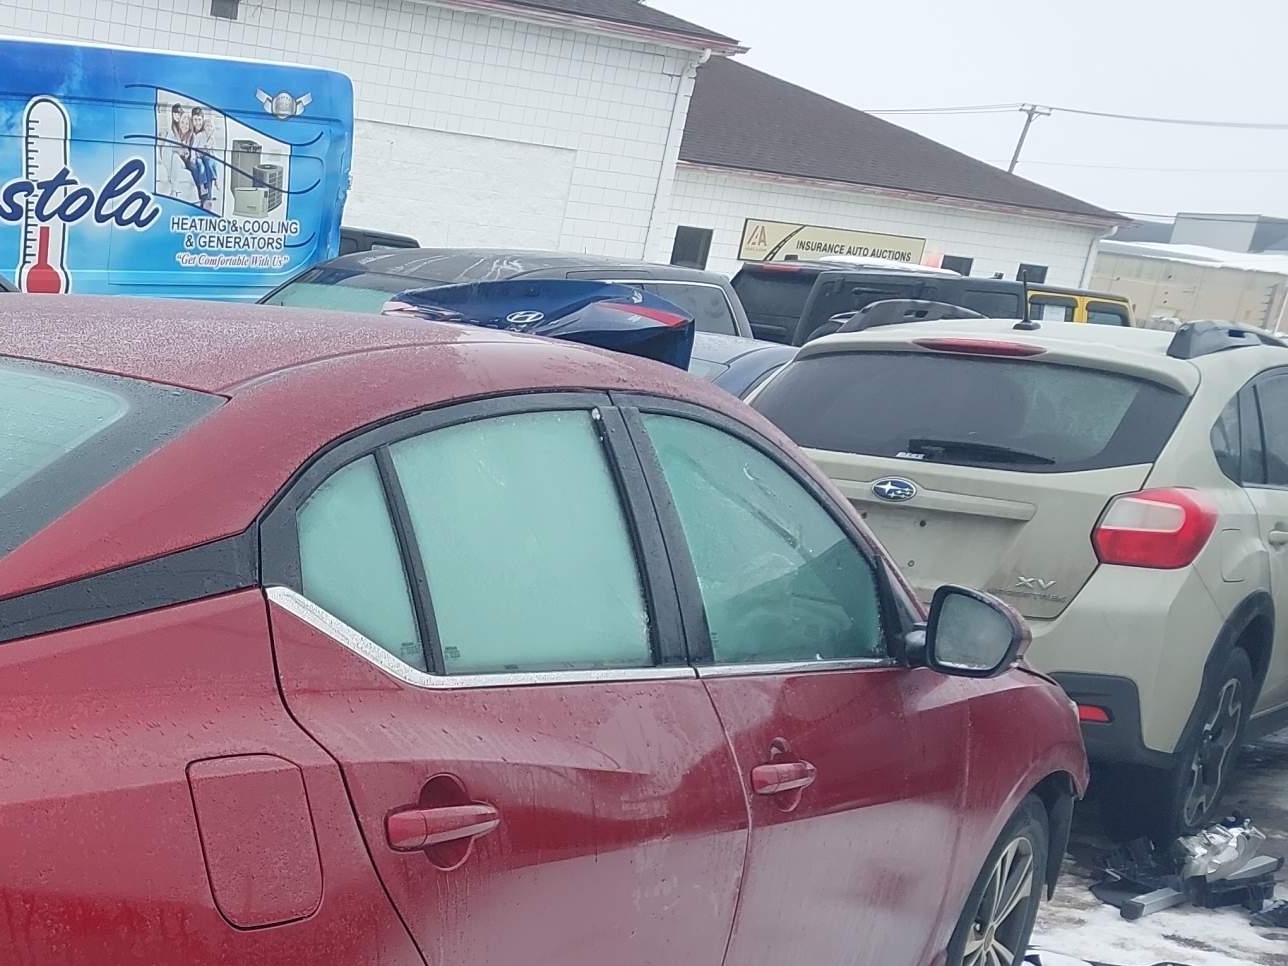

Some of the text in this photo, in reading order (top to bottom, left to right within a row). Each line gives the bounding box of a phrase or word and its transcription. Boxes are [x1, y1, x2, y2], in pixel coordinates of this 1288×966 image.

[171, 217, 298, 234] HEATING & COOLING
[185, 234, 283, 249] & GENERATORS
[796, 239, 912, 262] INSURANCE AUTO AUCTIONS
[198, 254, 249, 268] Comfortable
[252, 256, 270, 267] With
[1015, 576, 1056, 589] XV
